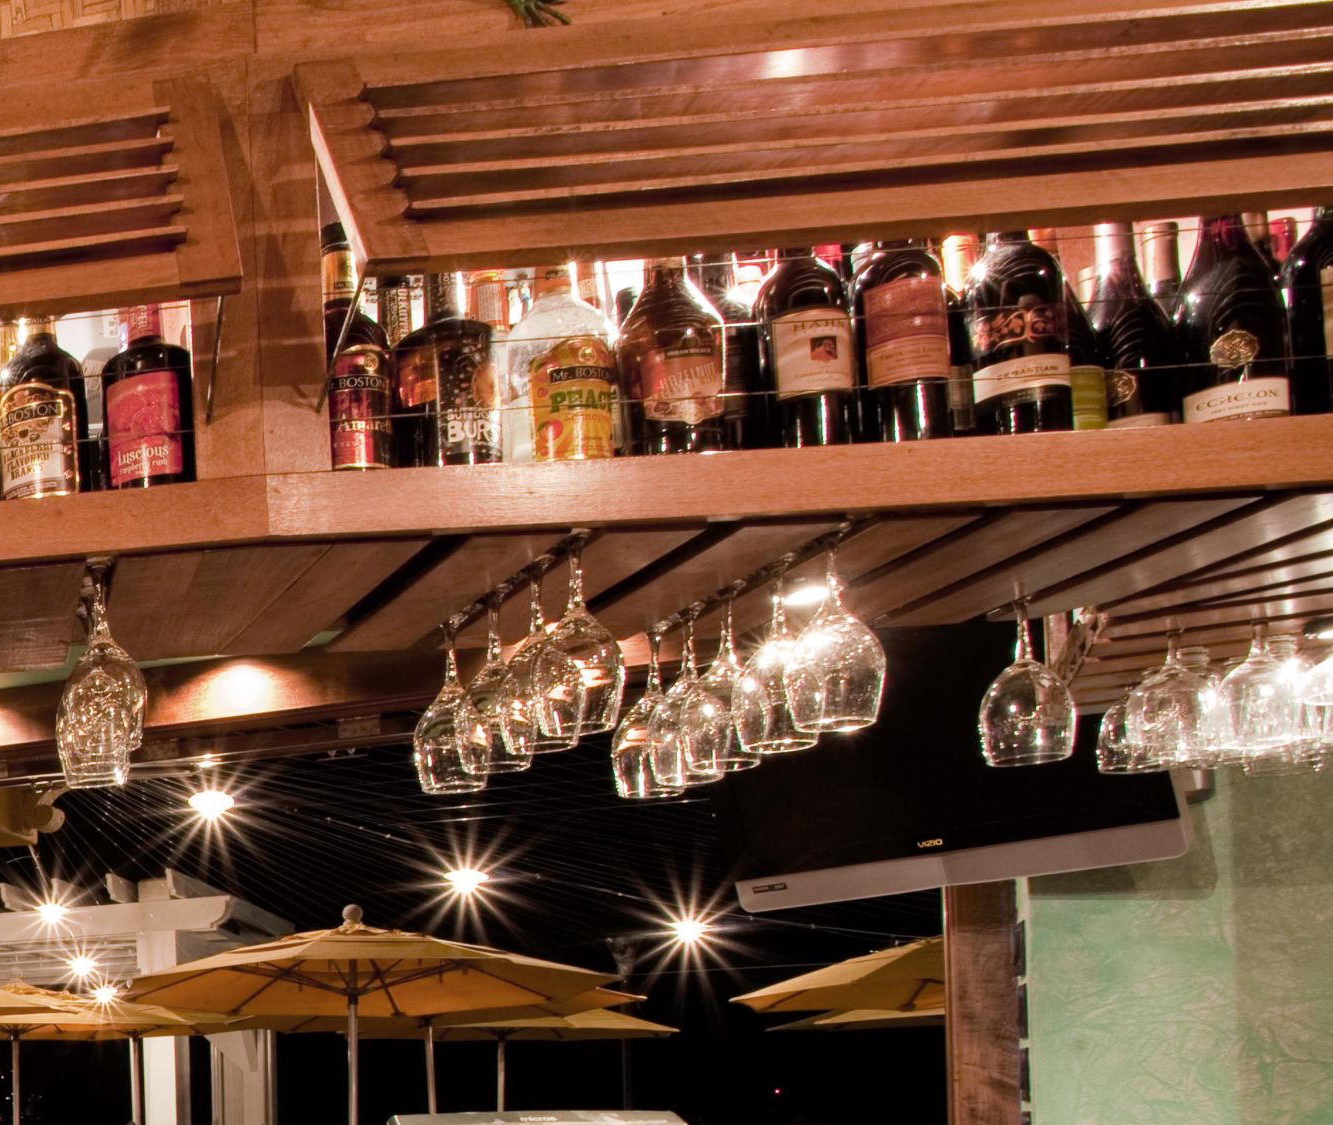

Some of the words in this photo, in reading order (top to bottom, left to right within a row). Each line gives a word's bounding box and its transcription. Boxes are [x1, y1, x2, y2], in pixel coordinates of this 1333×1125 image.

[8, 402, 60, 424] BOSTON
[117, 444, 170, 467] Luscious
[916, 838, 944, 849] VIZIO
